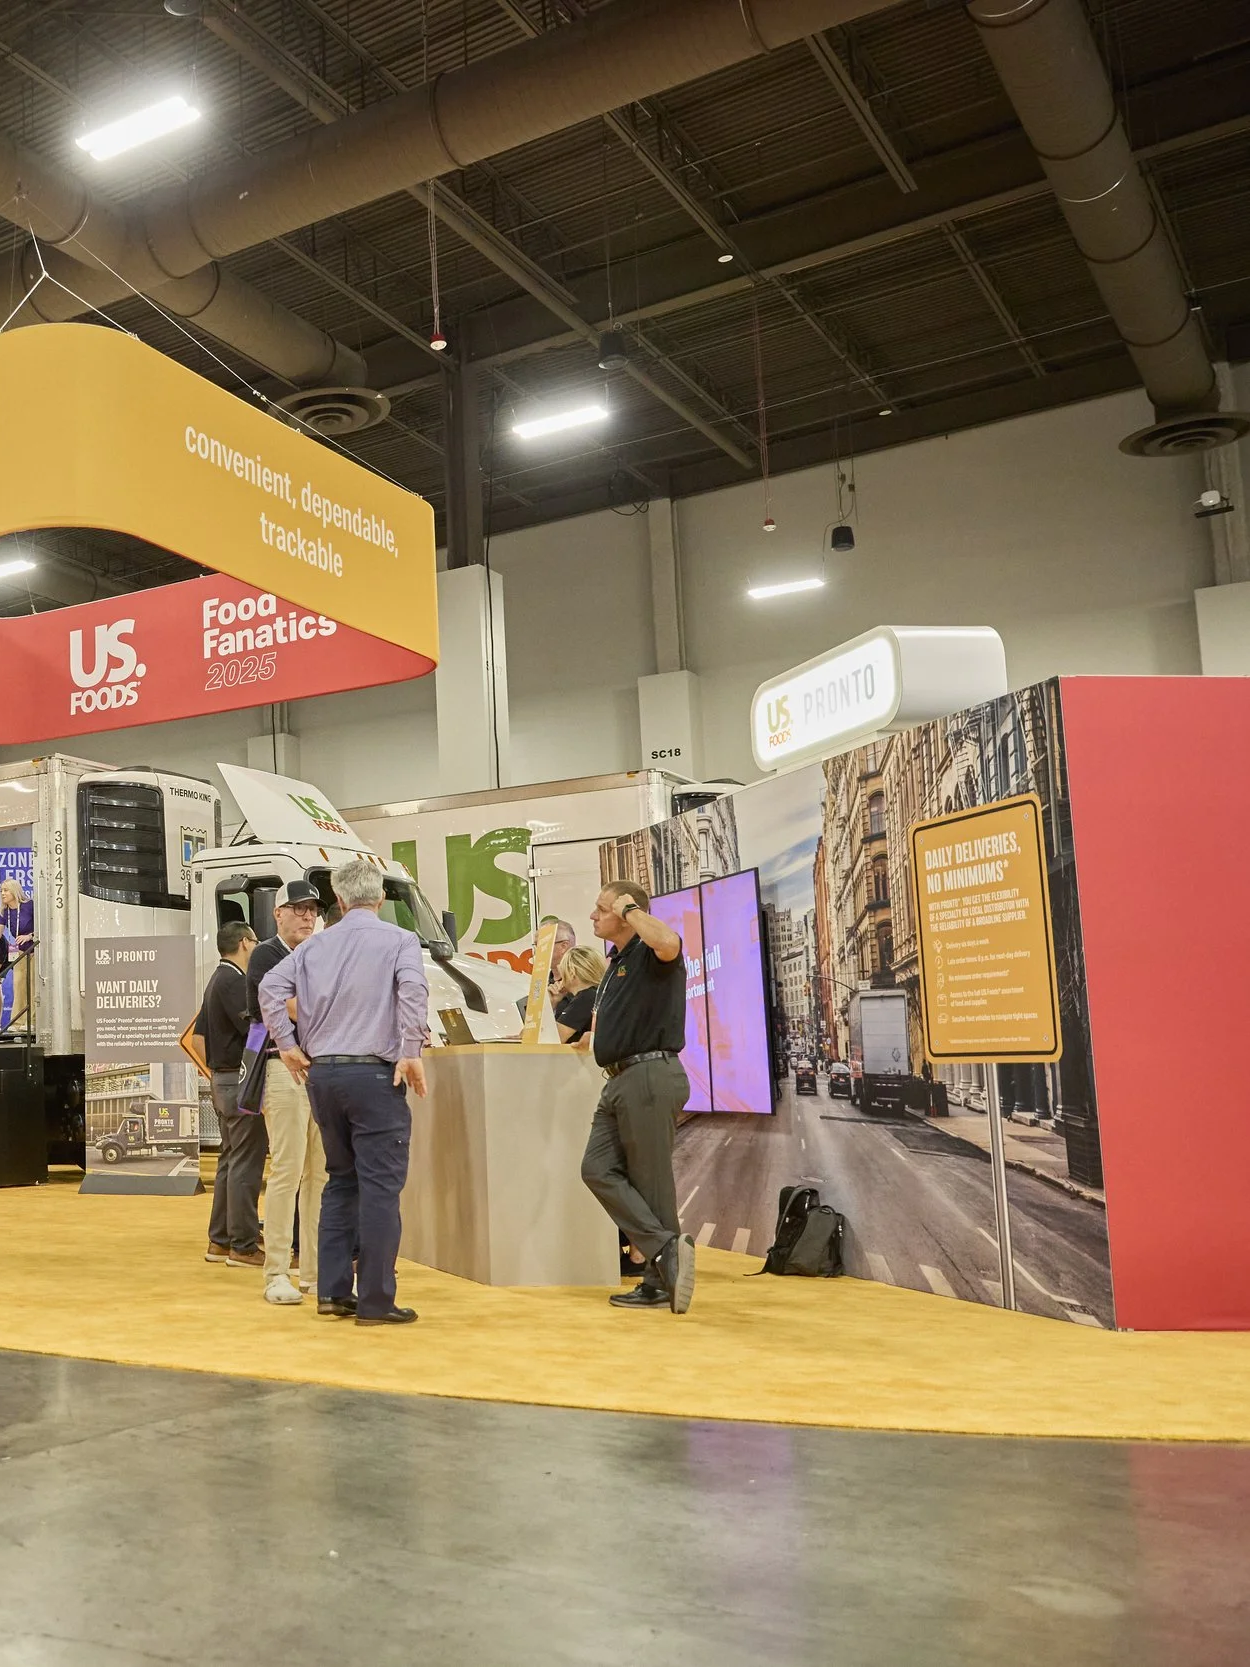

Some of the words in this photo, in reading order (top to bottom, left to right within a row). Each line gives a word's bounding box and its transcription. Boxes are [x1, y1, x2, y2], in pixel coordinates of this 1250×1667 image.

[185, 426, 297, 509] convenient,
[301, 482, 399, 558] dependable,
[260, 512, 343, 578] trackable
[203, 612, 337, 659] Fanatics
[70, 619, 147, 688] US.
[205, 652, 277, 691] 2025
[651, 748, 681, 759] SC18
[170, 787, 198, 799] THERMO
[199, 794, 211, 803] KING
[925, 845, 952, 870] DAILY
[955, 831, 1021, 864] DELIVERIES,
[54, 831, 64, 909] 361473
[926, 873, 941, 894] NO
[982, 892, 991, 903] THE
[930, 923, 939, 932] THE
[116, 950, 155, 962] PRONTO
[96, 981, 126, 993] WANT
[130, 980, 158, 993] DAILY
[96, 995, 161, 1009] DELIVERIES?
